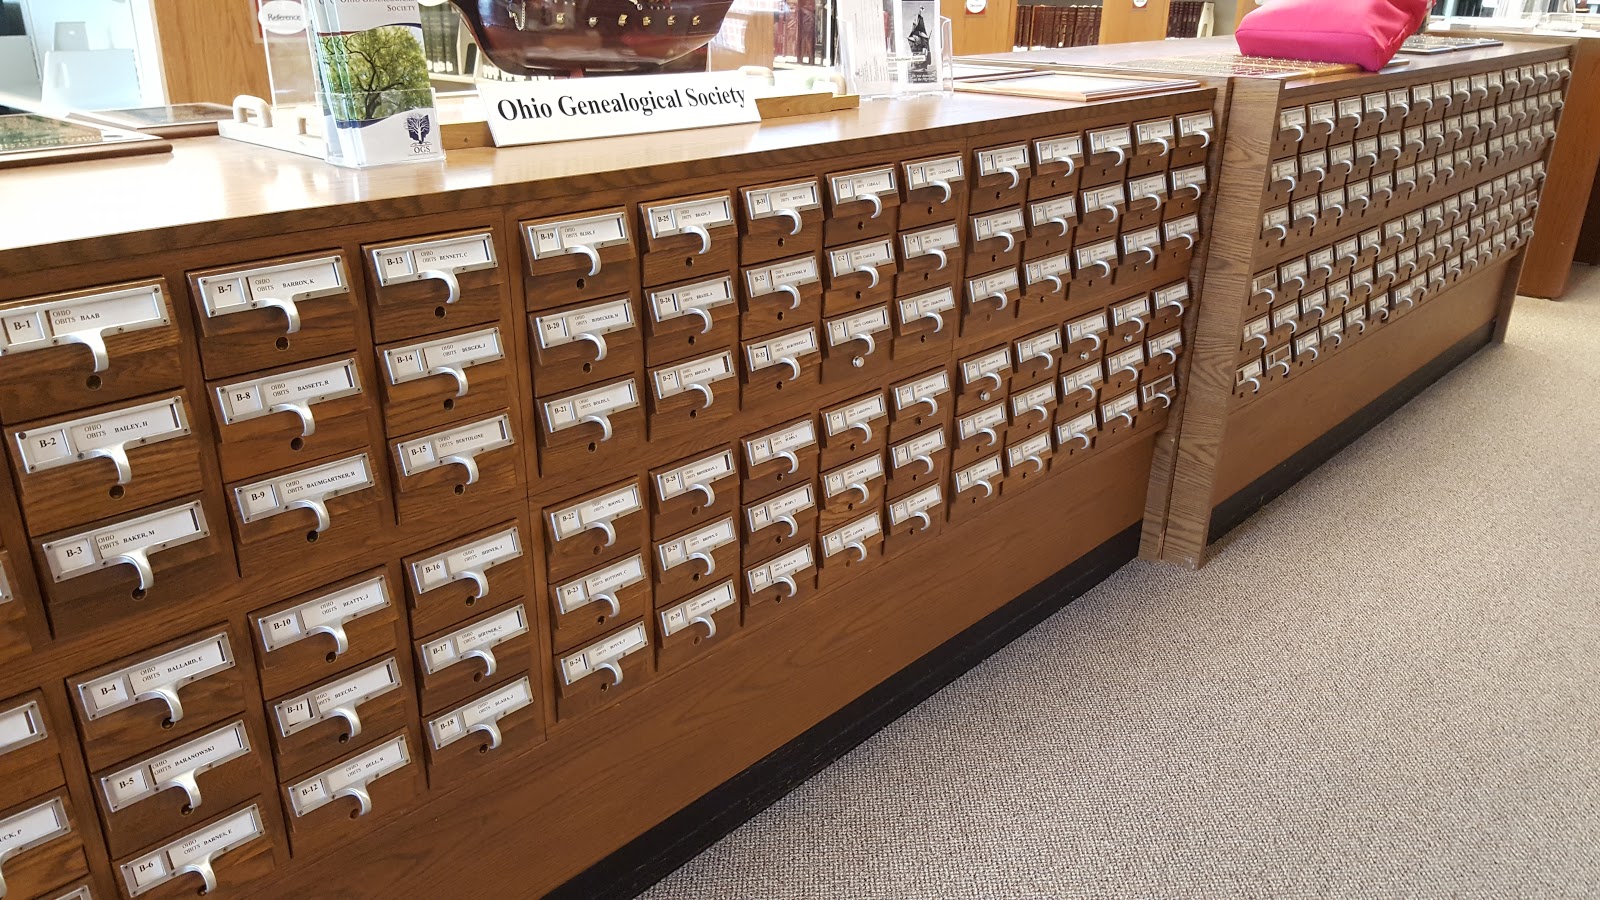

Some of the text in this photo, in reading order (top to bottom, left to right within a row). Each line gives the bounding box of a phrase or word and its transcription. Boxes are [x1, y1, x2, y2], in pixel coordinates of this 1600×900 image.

[268, 13, 301, 22] Reference
[497, 86, 745, 121] Ohio Genealogical Society
[413, 146, 431, 154] OGS
[540, 232, 554, 240] B-19
[386, 256, 404, 266] B-13
[439, 253, 464, 261] BENNETT,
[217, 284, 232, 294] B-7
[256, 284, 275, 292] OBITS
[282, 280, 310, 289] BARRON,
[53, 309, 71, 318] OHIO
[54, 312, 100, 326] OBITS BAAB
[13, 320, 31, 331] B-1
[546, 321, 560, 331] B-20
[396, 354, 413, 364] B-14
[271, 383, 286, 391] OHIO
[272, 389, 290, 397] OBITS
[297, 382, 325, 392] BASSETT,
[236, 391, 251, 402] B-8
[554, 405, 567, 414] B-21
[84, 423, 102, 433] OHIO
[86, 430, 107, 440] OBITS
[114, 423, 143, 434] BAILEY,
[39, 437, 57, 449] B-2
[411, 445, 427, 456] B-15
[286, 480, 300, 488] OHIO
[287, 486, 304, 495] OBITS
[306, 474, 351, 489] BAUMGARTNER,
[251, 491, 265, 501] B-9
[562, 512, 575, 522] B-22
[97, 534, 115, 544] OHIO
[99, 540, 120, 551] OBITS
[123, 532, 148, 544] BAKER,
[66, 546, 83, 558] B-3
[425, 563, 441, 574] B-16
[566, 586, 579, 596] B-23
[320, 601, 334, 609] OHIO
[321, 606, 338, 616] OBITS
[343, 595, 366, 607] BEATTY,
[273, 618, 291, 630] B-10
[432, 643, 447, 655] B-17
[569, 656, 582, 667] B-24
[140, 666, 156, 676] OHIO
[142, 671, 161, 683] OBITS
[167, 659, 198, 674] BALLARD,
[100, 684, 117, 696] B-4
[287, 703, 304, 714] B-11
[440, 718, 454, 730] B-18
[151, 759, 168, 770] OHIO
[154, 745, 216, 776] OBITS BARANOWSKI
[118, 777, 135, 789] B-5
[301, 783, 319, 796] B-12
[0, 833, 17, 843] UCK,
[182, 838, 197, 849] OHIO
[183, 843, 201, 855] OBITS
[203, 833, 227, 846] BARNES,
[138, 861, 154, 873] B-6
